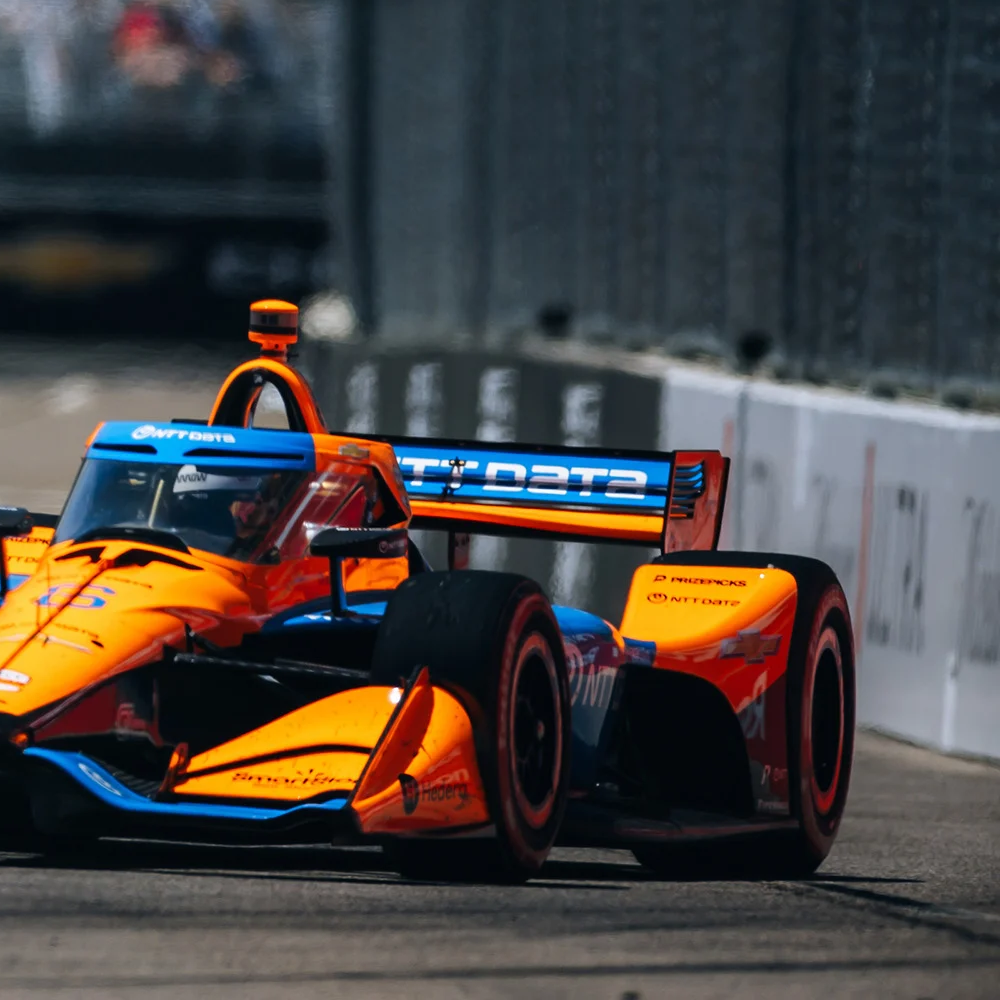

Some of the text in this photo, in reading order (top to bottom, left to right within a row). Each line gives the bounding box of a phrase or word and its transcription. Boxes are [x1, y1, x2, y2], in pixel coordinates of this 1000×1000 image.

[394, 457, 478, 490] TT
[670, 577, 747, 587] PRIZEPICKS
[670, 596, 700, 604] NTT
